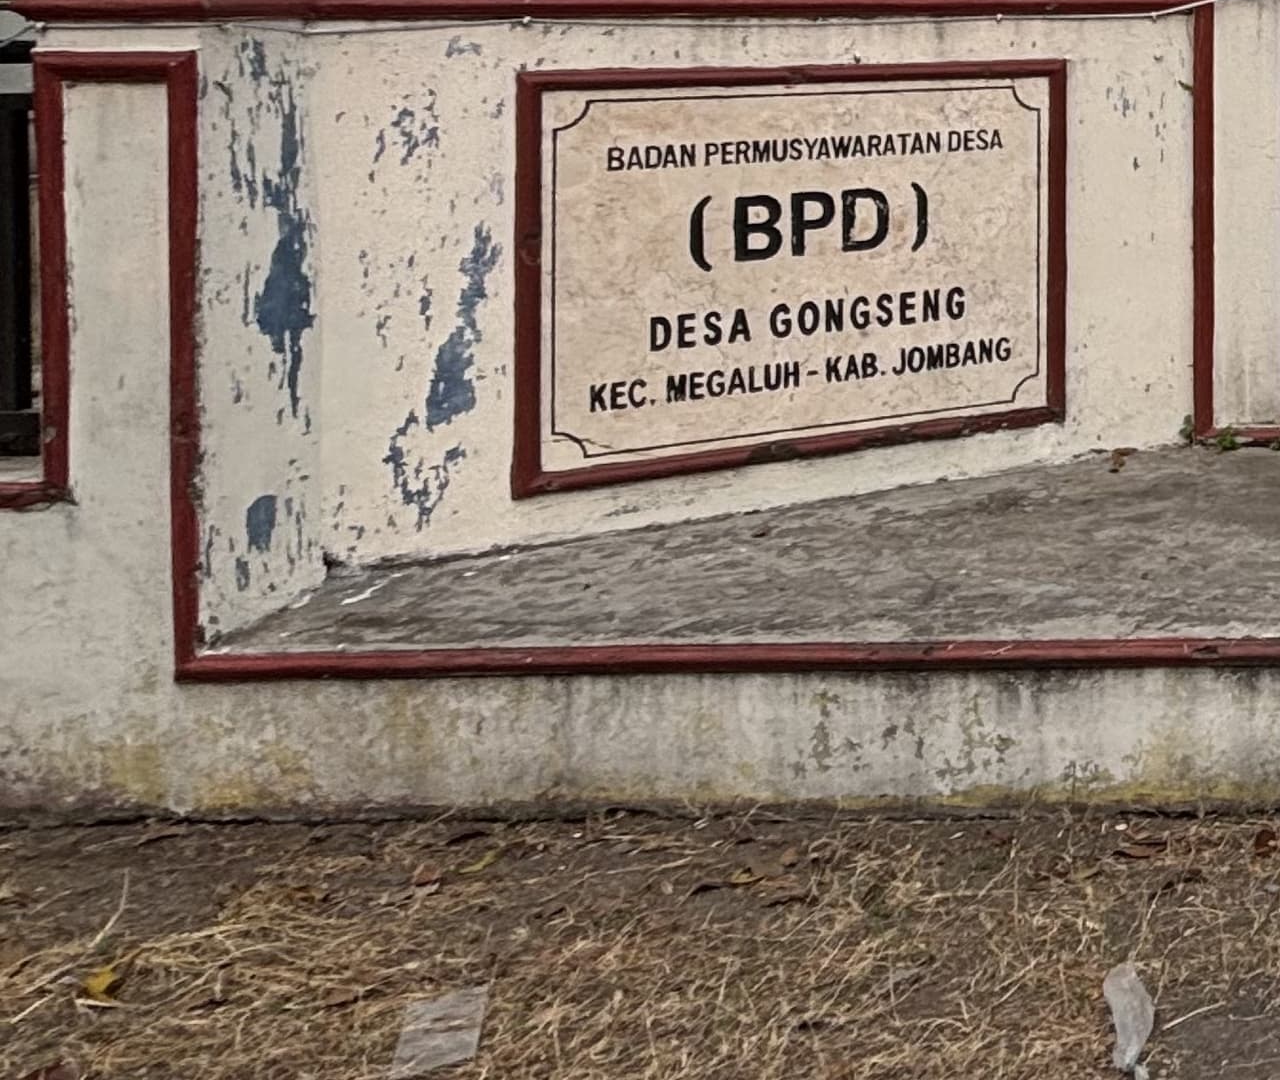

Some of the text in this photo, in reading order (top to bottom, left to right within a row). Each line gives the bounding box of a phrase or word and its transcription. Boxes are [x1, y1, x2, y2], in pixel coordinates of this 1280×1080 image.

[606, 129, 1004, 172] BADAN PERMUSYAWARATAN DESA
[649, 286, 965, 352] DESA GONGSENG
[589, 378, 657, 413] KEC.
[665, 360, 800, 404] MEGALUH
[825, 352, 886, 383] KAB.
[892, 337, 1012, 377] JOMBANG
